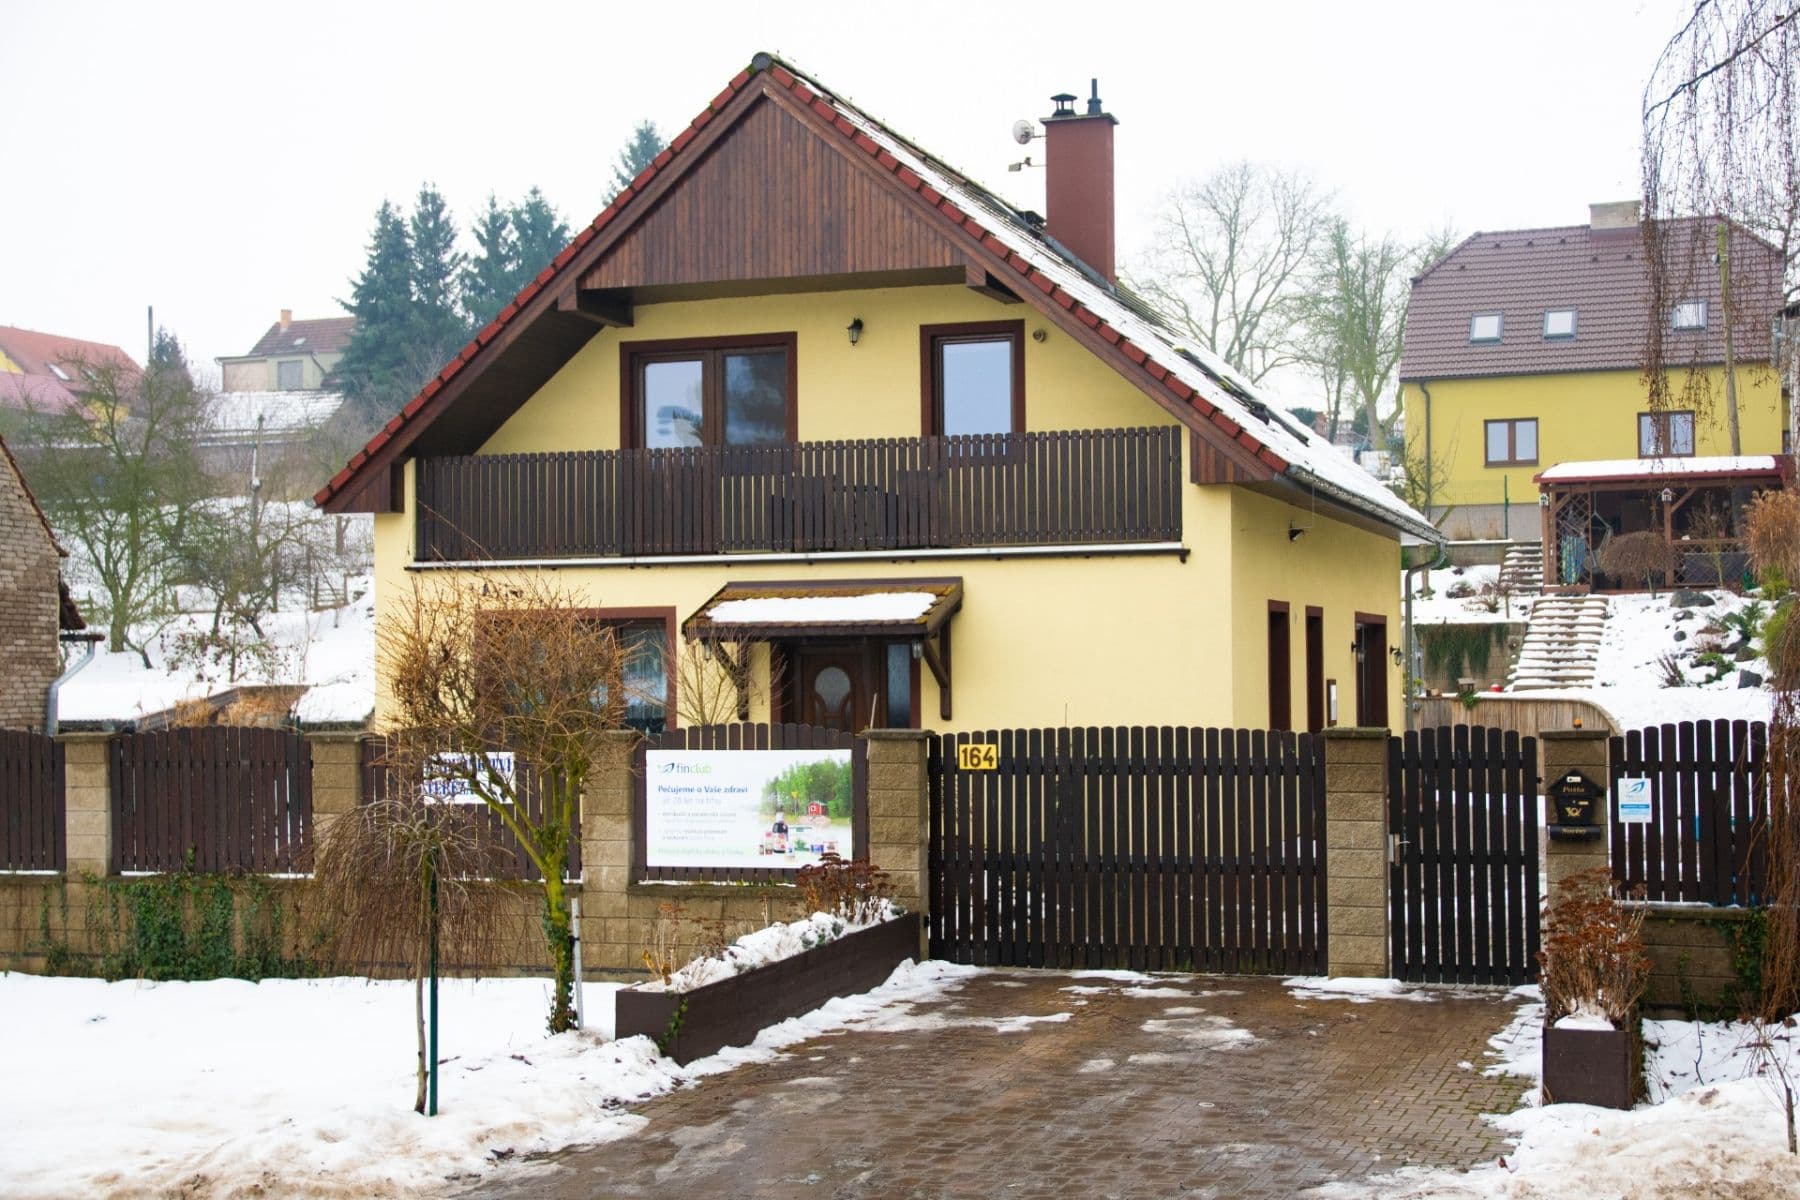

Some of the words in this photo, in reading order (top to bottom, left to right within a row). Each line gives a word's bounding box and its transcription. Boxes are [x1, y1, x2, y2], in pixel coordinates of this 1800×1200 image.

[962, 747, 994, 768] 164
[676, 762, 712, 774] finclub
[658, 785, 695, 795] Pečujeme
[704, 785, 721, 793] Vaše
[724, 785, 748, 793] zdraví
